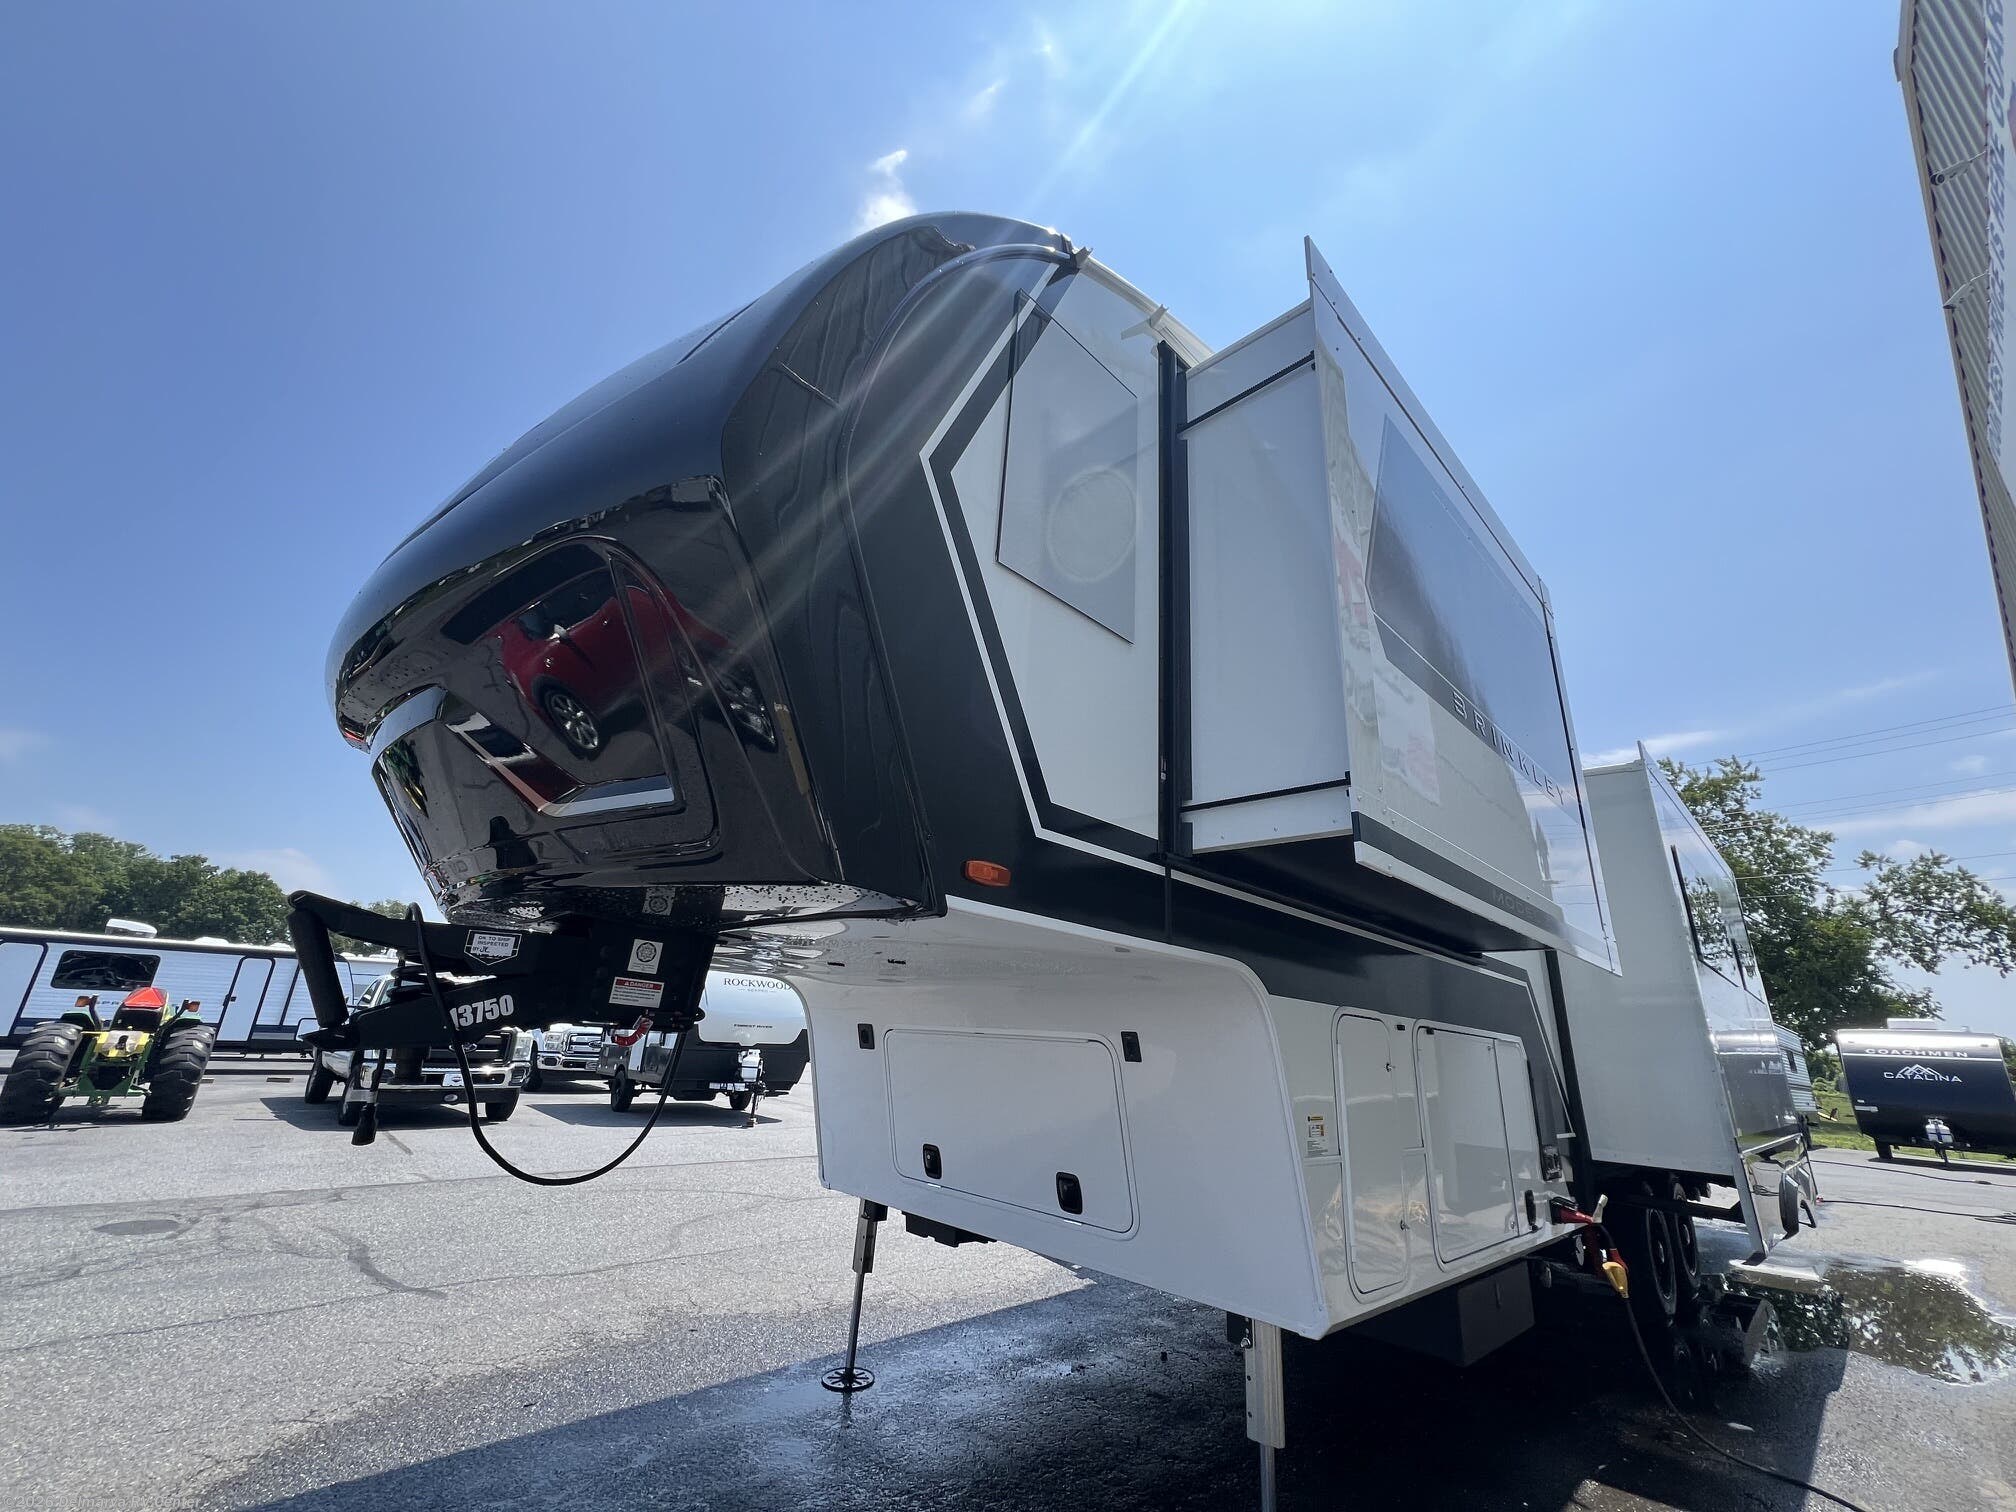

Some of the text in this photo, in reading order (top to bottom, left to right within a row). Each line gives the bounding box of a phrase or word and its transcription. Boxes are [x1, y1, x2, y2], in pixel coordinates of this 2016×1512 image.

[1990, 127, 2005, 232] HERE
[1990, 222, 2005, 271] IS
[1453, 690, 1564, 805] BRINKLEY
[724, 977, 792, 991] ROCKWOOD
[449, 994, 514, 1032] 13750
[1865, 1047, 1969, 1058] COACHMEN
[1883, 1071, 1963, 1083] CATALINA
